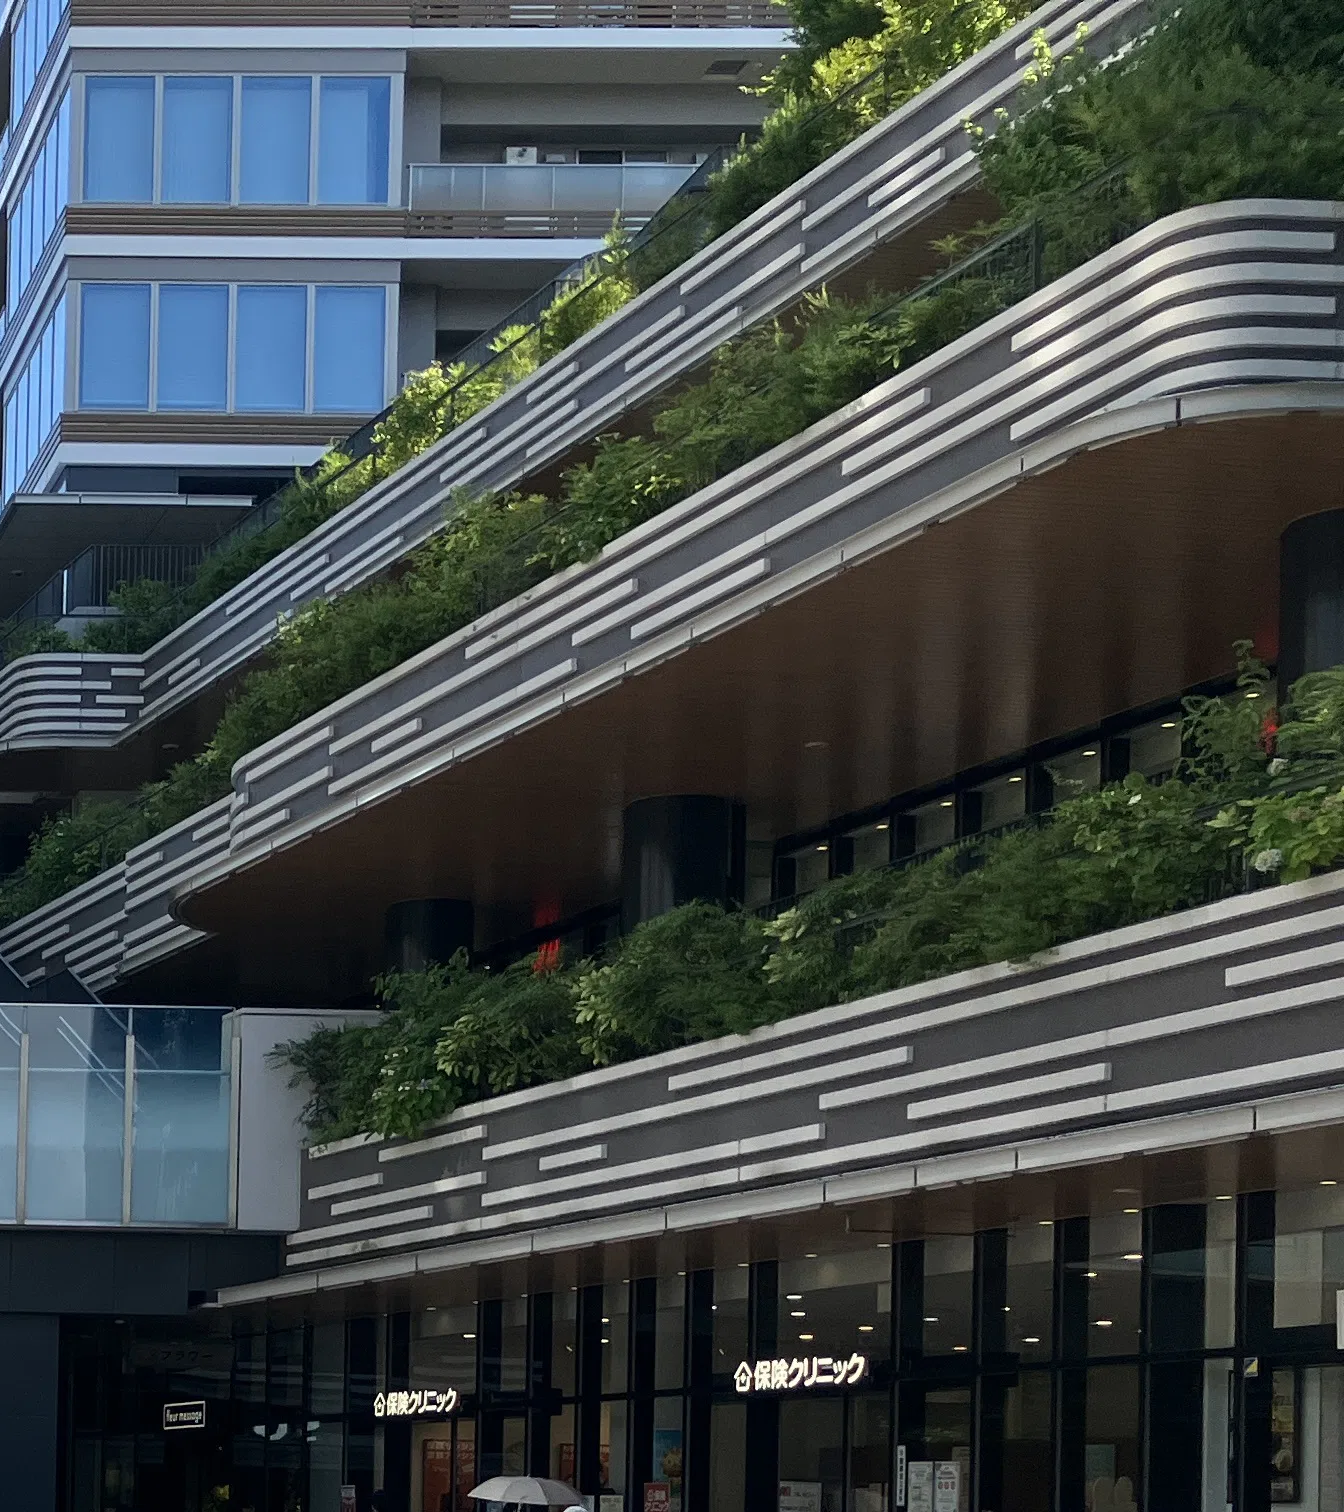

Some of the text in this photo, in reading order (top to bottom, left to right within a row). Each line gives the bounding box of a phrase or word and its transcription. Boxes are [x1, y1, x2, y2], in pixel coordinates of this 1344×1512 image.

[754, 1352, 865, 1390] 保険クリニック
[386, 1388, 457, 1416] 保険クリニック
